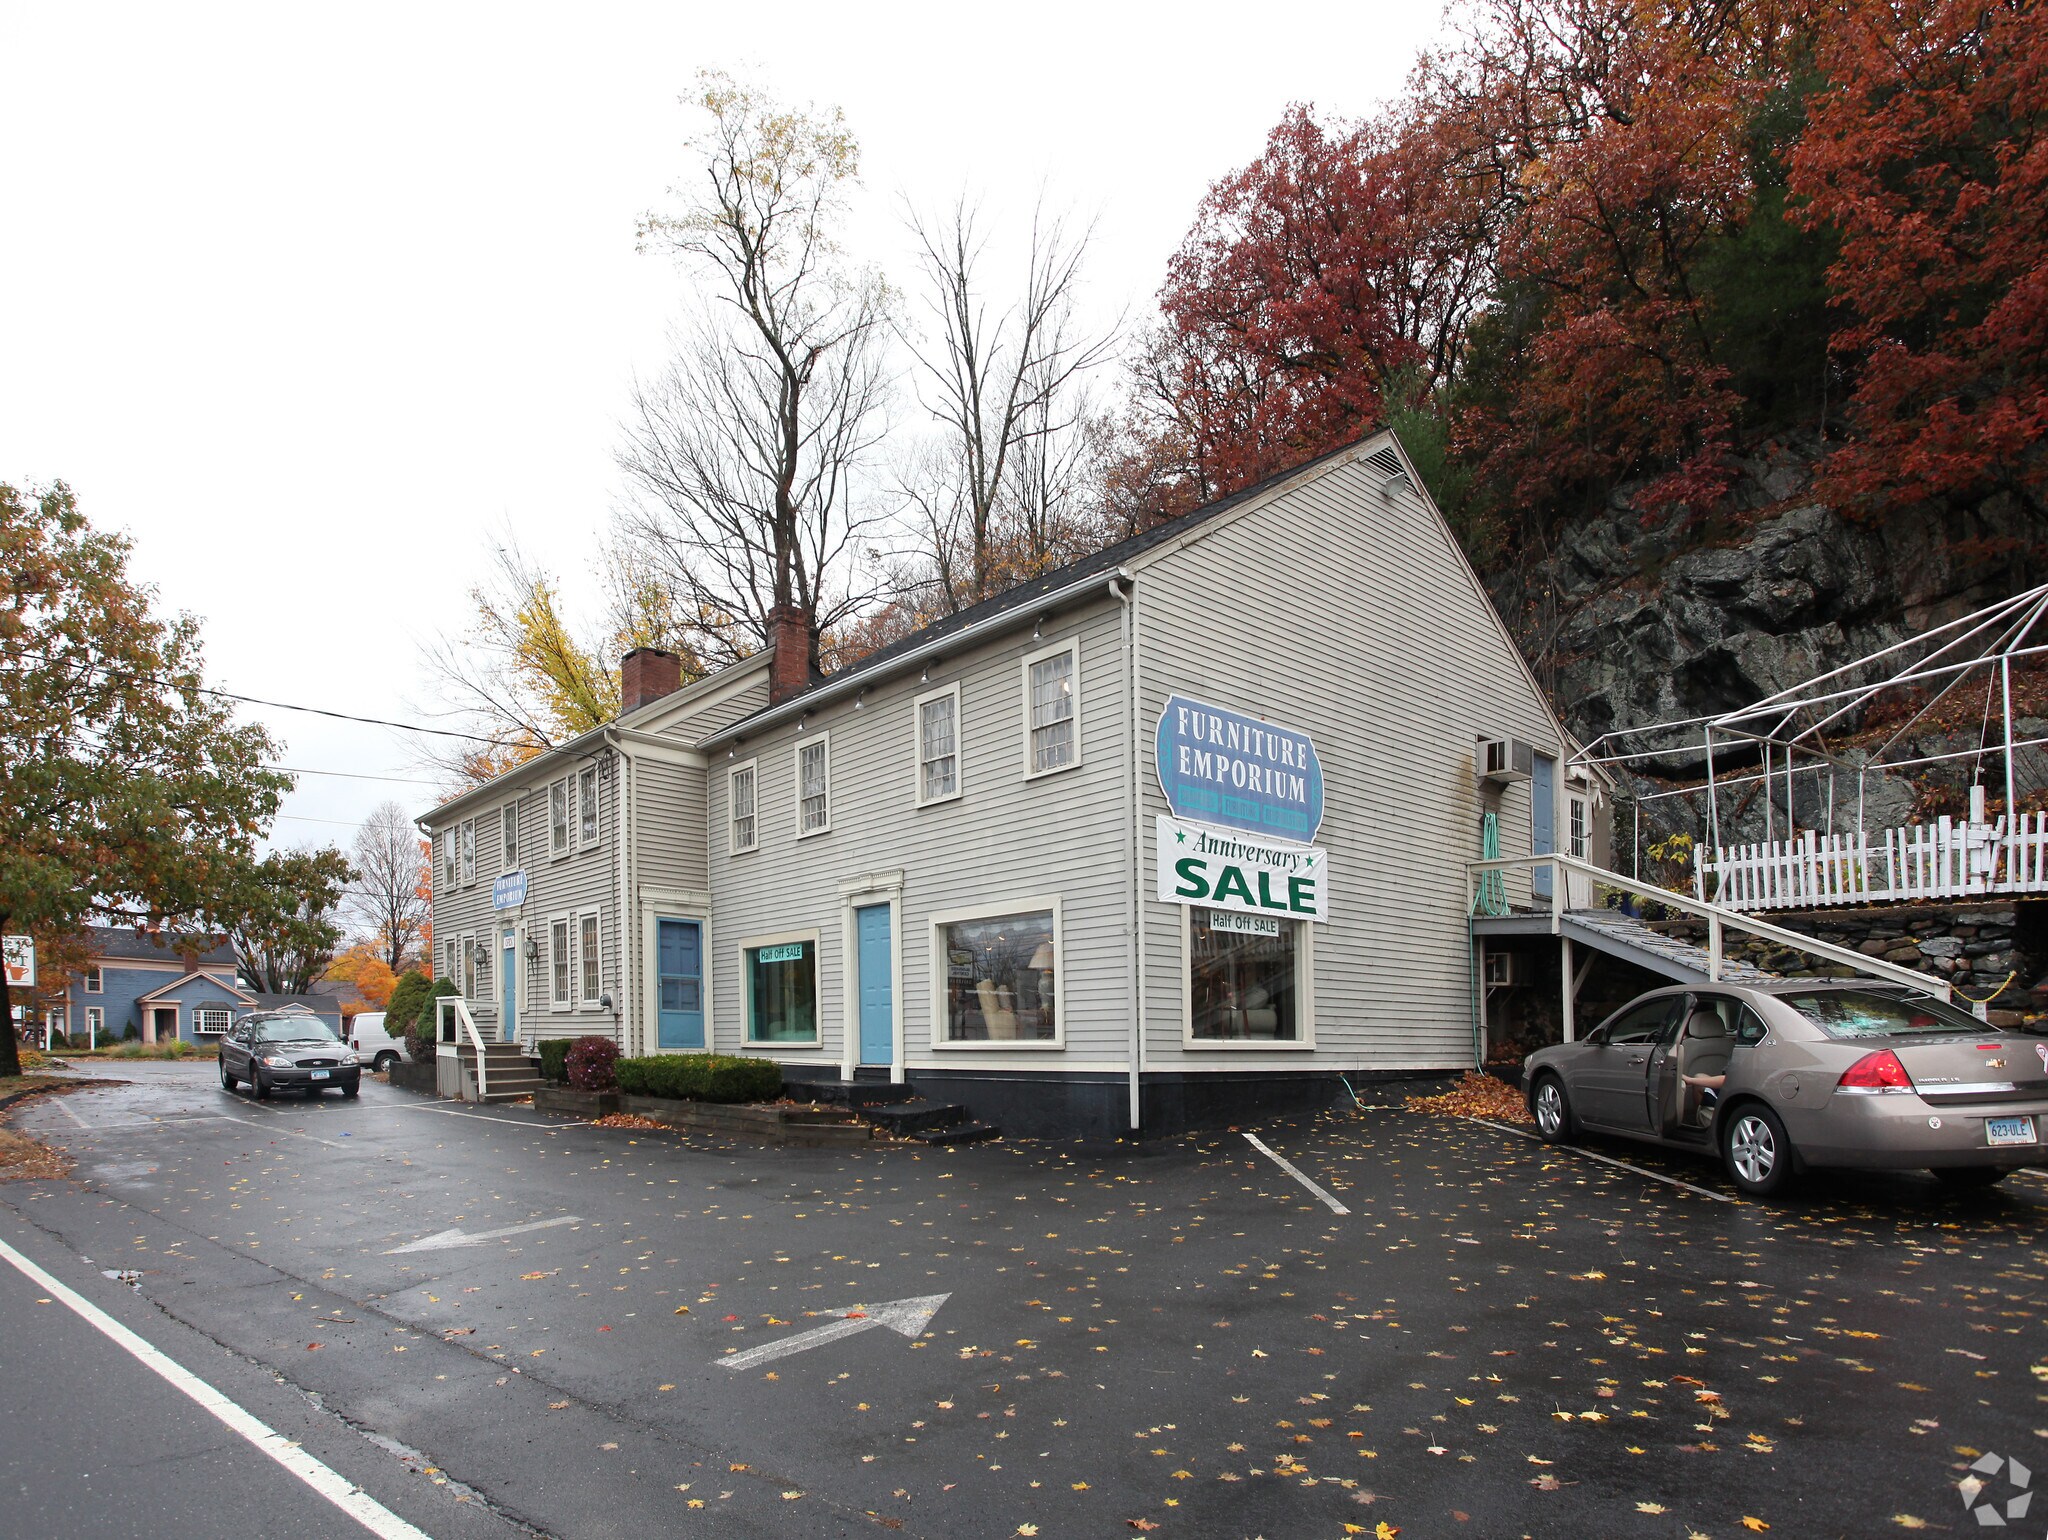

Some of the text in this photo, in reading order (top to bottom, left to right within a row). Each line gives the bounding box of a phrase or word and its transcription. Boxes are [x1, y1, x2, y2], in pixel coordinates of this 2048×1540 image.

[1177, 705, 1307, 771] FURNITURE
[1179, 745, 1306, 804] EMPORIUM
[1193, 830, 1300, 873] Anniversary
[496, 874, 523, 891] FURNITURE
[496, 889, 523, 904] EMPORIUM
[1175, 857, 1317, 915] SALE
[1213, 914, 1276, 933] Half Off SALE
[761, 946, 801, 960] Half Off SALE
